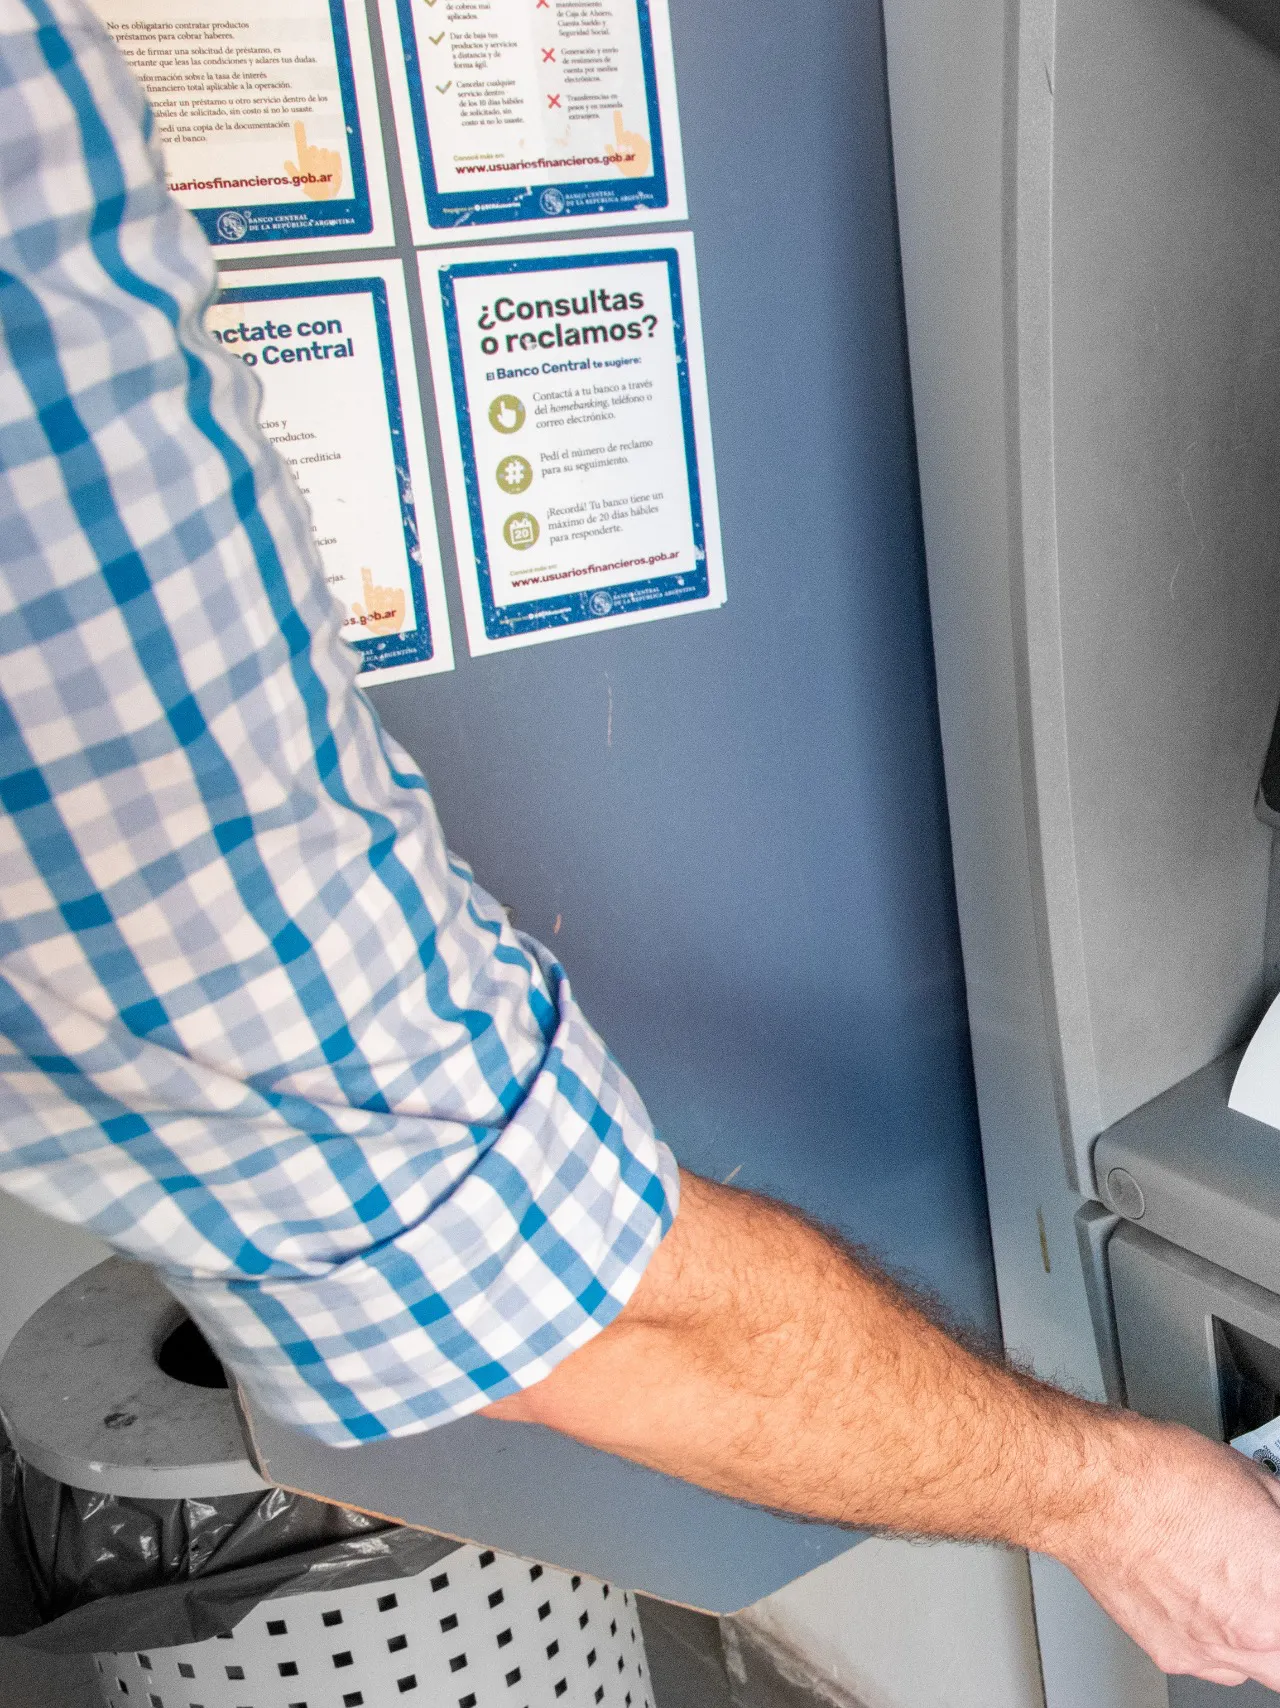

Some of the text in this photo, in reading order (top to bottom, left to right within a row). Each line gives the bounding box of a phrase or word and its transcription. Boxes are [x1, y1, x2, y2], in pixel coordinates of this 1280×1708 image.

[212, 21, 249, 30] productos
[116, 33, 156, 42] préstamos
[158, 34, 176, 42] para
[191, 46, 222, 55] solicitud
[225, 46, 233, 54] de
[159, 60, 173, 68] que
[203, 56, 247, 65] condiciones
[255, 56, 280, 64] aclares
[185, 72, 205, 80] sobre
[146, 84, 185, 92] financiero
[206, 82, 238, 92] aplicable
[191, 100, 227, 108] préstamo
[282, 95, 306, 103] dentro
[230, 107, 240, 115] sin
[193, 124, 213, 133] copia
[234, 122, 290, 130] documentación
[274, 214, 308, 222] CENTRAL
[478, 288, 644, 330] ¿Consultas
[297, 319, 342, 336] con
[480, 314, 658, 355] o reclamos?
[262, 338, 354, 365] Central
[486, 356, 642, 381] El Banco Central te sugiere:
[532, 380, 653, 402] Contactá tu banco través
[534, 405, 548, 415] del
[550, 400, 610, 413] homebanking,
[612, 394, 645, 405] teléfono
[536, 411, 616, 429] correo electrónico.
[300, 452, 342, 464] crediticia
[540, 440, 653, 462] Pedí el número de reclamo
[541, 466, 561, 478] para
[547, 492, 664, 519] ¡Recordá! Tu banco tiene un
[548, 506, 659, 530] máximo de 20 días hábiles
[514, 530, 529, 539] 20
[550, 526, 624, 546] para responderte.
[511, 550, 680, 588] www.usuariosfinancieros.gob.ar
